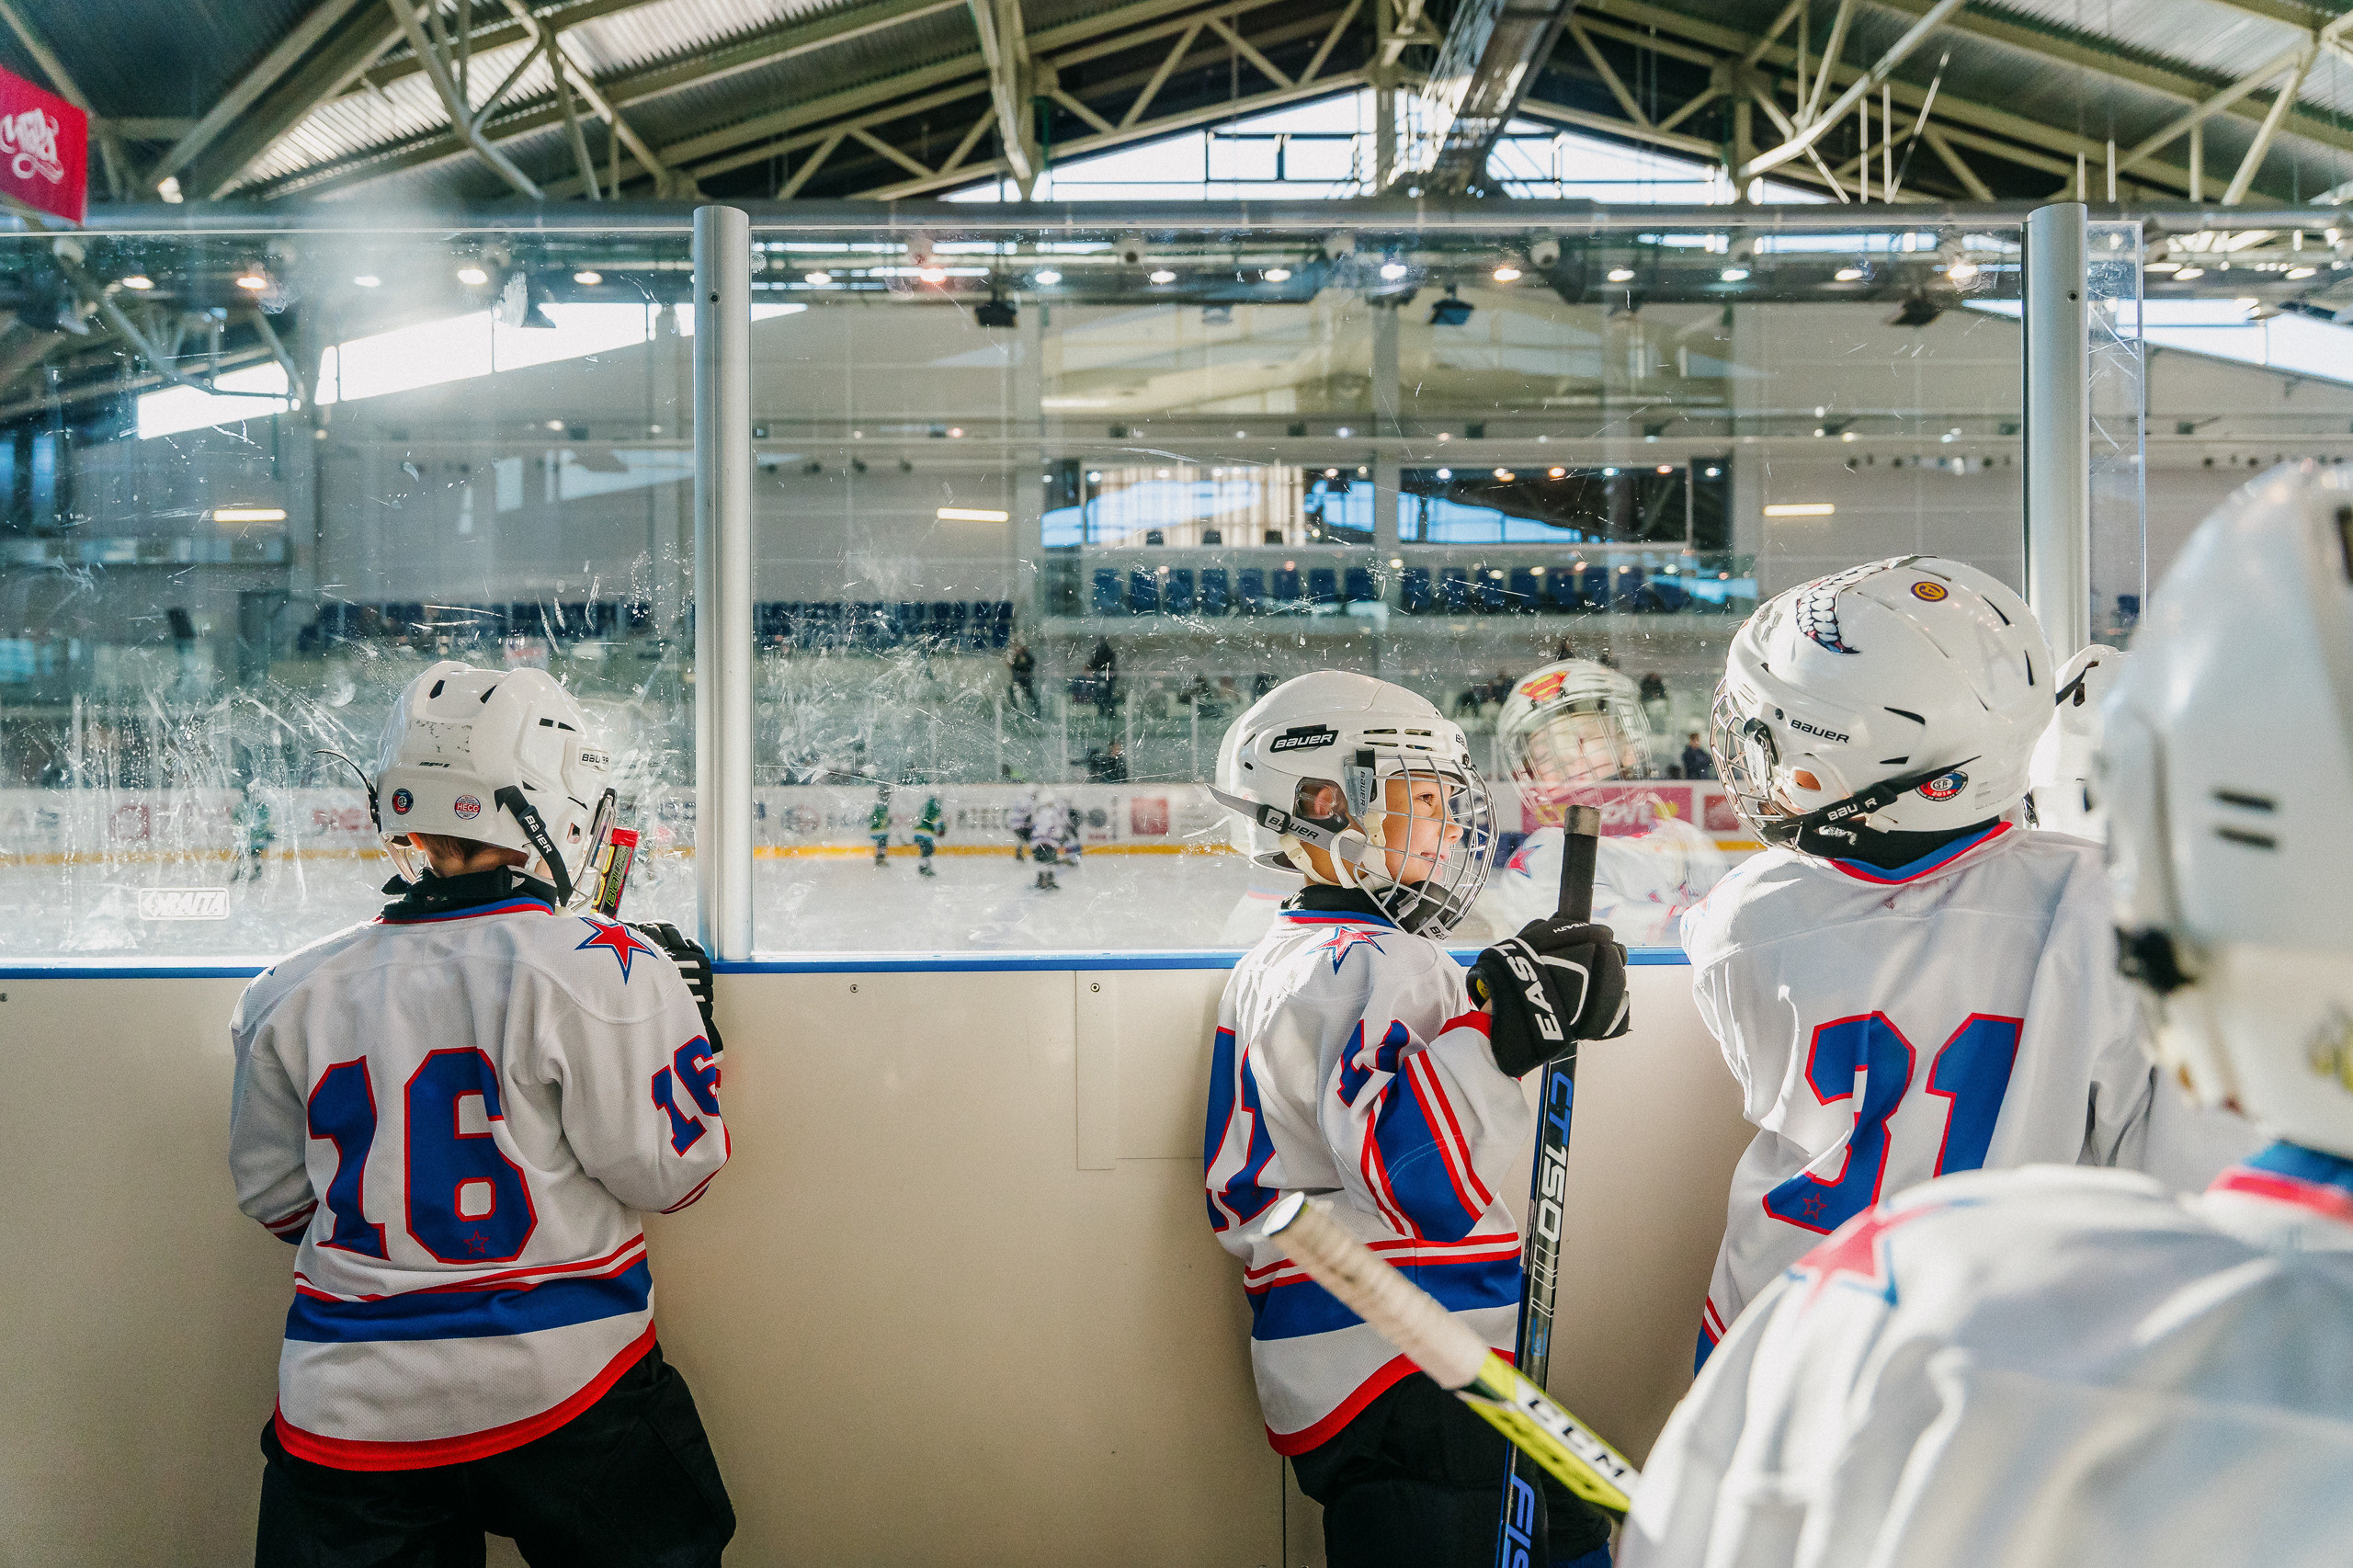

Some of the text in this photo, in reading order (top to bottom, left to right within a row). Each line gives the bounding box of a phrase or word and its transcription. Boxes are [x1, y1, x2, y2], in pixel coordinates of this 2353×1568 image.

[1274, 733, 1334, 749] BAUER
[1790, 719, 1850, 744] BAUER
[457, 802, 480, 812] HECC
[1827, 797, 1877, 821] BAUR
[652, 1035, 721, 1157] 16
[1762, 1010, 2025, 1235] 31
[308, 1046, 539, 1265] 16
